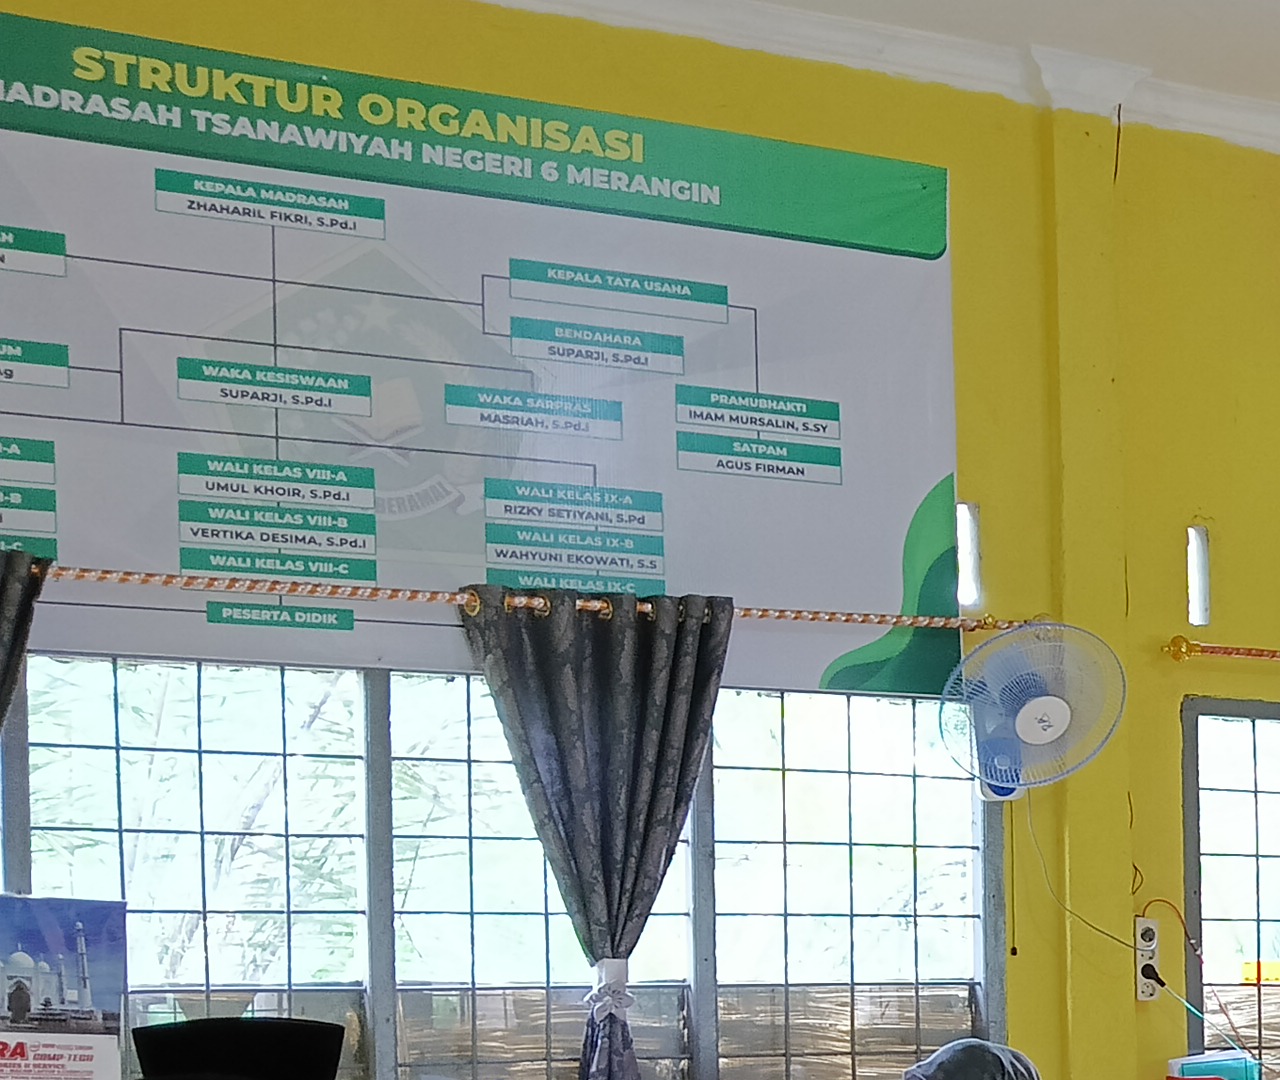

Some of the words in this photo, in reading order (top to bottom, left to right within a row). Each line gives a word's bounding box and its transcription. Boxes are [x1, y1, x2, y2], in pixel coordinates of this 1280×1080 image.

[71, 46, 344, 120] STRUKTUR
[357, 93, 644, 164] ORGANISASI
[191, 109, 412, 162] TSANAWIYAH
[422, 142, 532, 180] NEGERI
[541, 161, 560, 183] 6
[567, 166, 721, 206] MERANGIN
[194, 179, 256, 200] KEPALA
[260, 187, 350, 211] MADRASAH
[187, 199, 266, 220] ZHAHARIL
[270, 209, 313, 228] FIKRI,
[316, 215, 357, 232] S.Pd.I
[547, 267, 602, 285] KEPALA
[606, 275, 640, 290] TATA
[644, 279, 692, 297] USAHA
[554, 326, 642, 348] BENDAHARA
[547, 344, 609, 365] SUPARJI,
[611, 351, 649, 367] S.Pd.I
[202, 363, 252, 382] WAKA
[255, 369, 349, 391] KESISWAAN
[220, 387, 288, 405] SUPARJI,
[291, 393, 332, 409] S.Pd.I
[477, 392, 523, 409] WAKA
[526, 396, 592, 415] SARPRAS
[709, 392, 808, 414] PRAMUBHAKTI
[479, 411, 549, 430] MASRIAH,
[551, 417, 590, 433] S.Pd.I
[688, 409, 725, 423] IMAM
[728, 413, 799, 432] MURSALIN,
[801, 420, 829, 435] S.SY
[732, 441, 788, 458] SATPAM
[207, 459, 250, 475] WALI
[252, 464, 302, 480] KELAS
[305, 467, 348, 483] VIII-A
[716, 458, 752, 473] AGUS
[754, 462, 806, 477] FIRMAN
[205, 480, 249, 495] UMUL
[253, 484, 306, 501] KHOIR,
[309, 487, 350, 502] S.Pd.I
[515, 485, 555, 500] WALI
[557, 488, 601, 504] KELAS
[603, 493, 633, 507] IX-A
[209, 506, 250, 522] WALI
[253, 510, 303, 526] KELAS
[306, 514, 349, 530] VIII-B
[503, 503, 544, 519] RIZKY
[547, 506, 613, 525] SETIYANI,
[615, 511, 646, 526] S.Pd
[189, 527, 256, 544] VERTIKA
[259, 532, 323, 549] DESIMA,
[326, 535, 367, 551] S.Pd.I
[516, 529, 555, 544] WALI
[557, 533, 602, 548] KELAS
[605, 536, 635, 550] IX-B
[209, 554, 251, 570] WALI
[253, 557, 304, 574] KELAS
[307, 561, 349, 576] VIII-C
[494, 548, 564, 566] WAHYUNI
[566, 552, 634, 571] EKOWATI,
[636, 557, 657, 571] S.S
[517, 574, 556, 589] WALI
[558, 578, 603, 592] KELAS
[606, 580, 636, 594] IX-C
[221, 607, 290, 624] PESERTA
[293, 610, 339, 626] DIDIK
